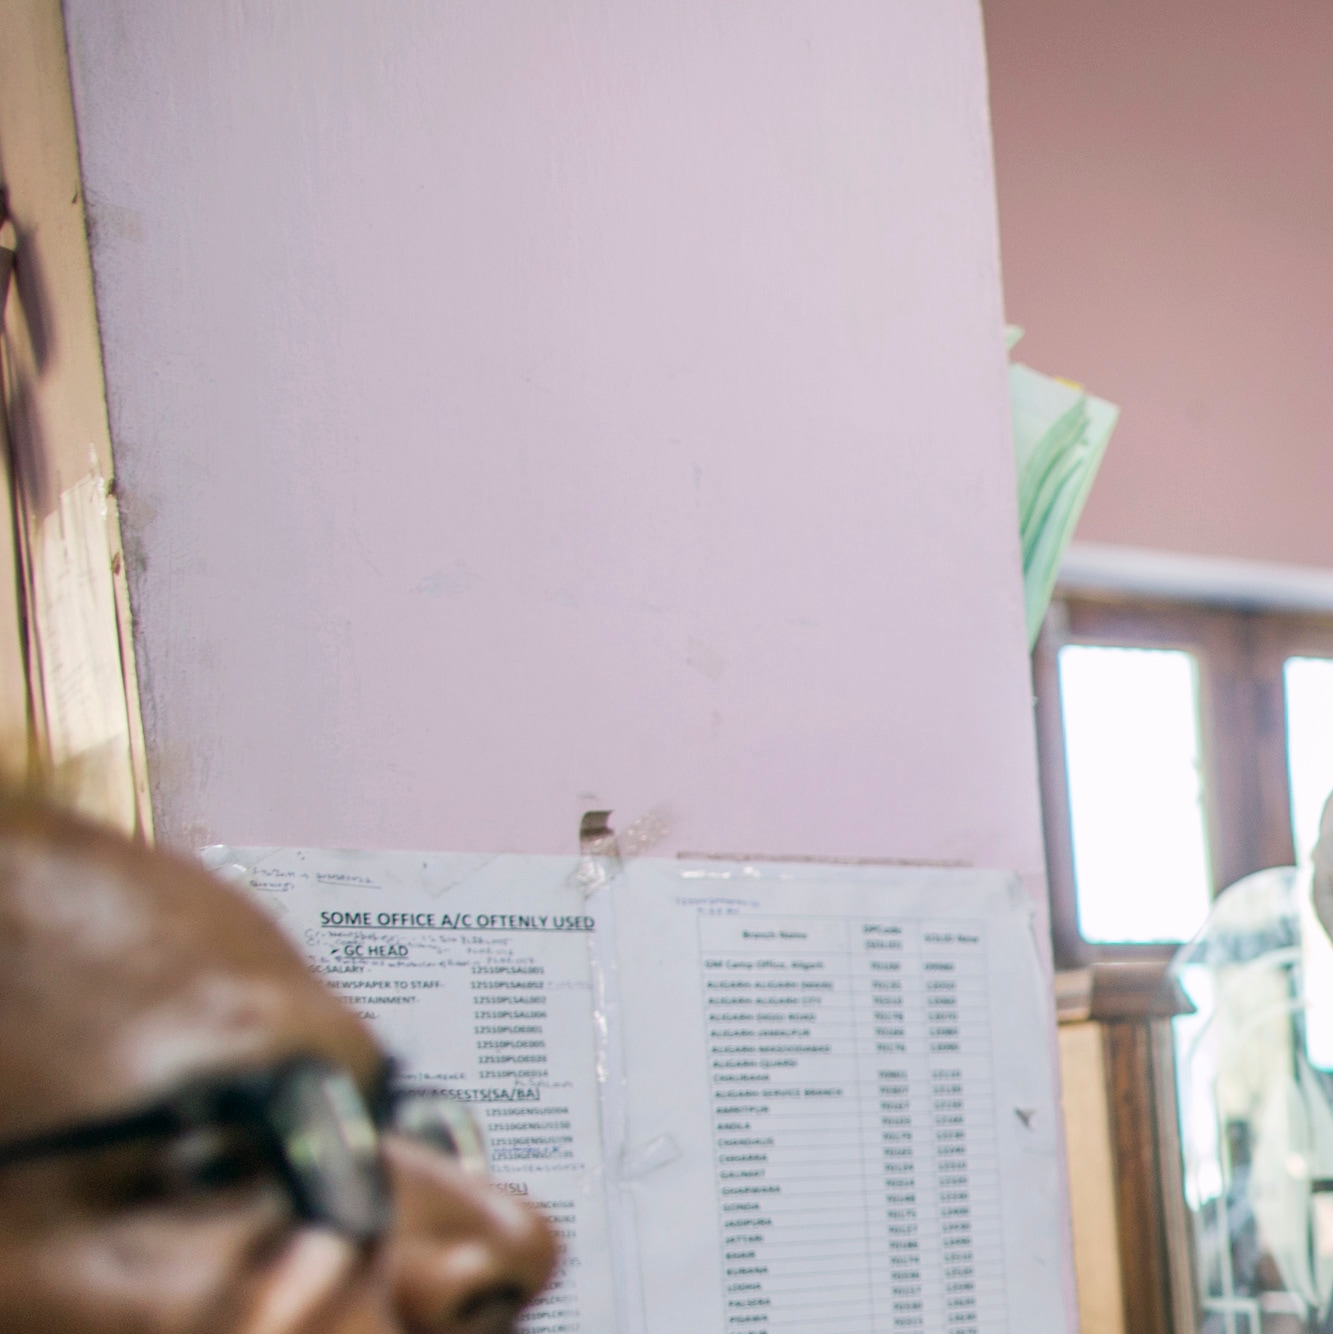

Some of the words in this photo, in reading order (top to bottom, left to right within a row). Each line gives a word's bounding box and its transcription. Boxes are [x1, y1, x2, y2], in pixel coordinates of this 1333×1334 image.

[320, 911, 371, 927] SOME
[377, 912, 436, 927] OFFICE
[440, 913, 472, 929] A/C
[479, 915, 548, 929] OFTENLY
[553, 916, 595, 929] USED
[344, 945, 364, 958] GC
[368, 945, 409, 958] HEAD
